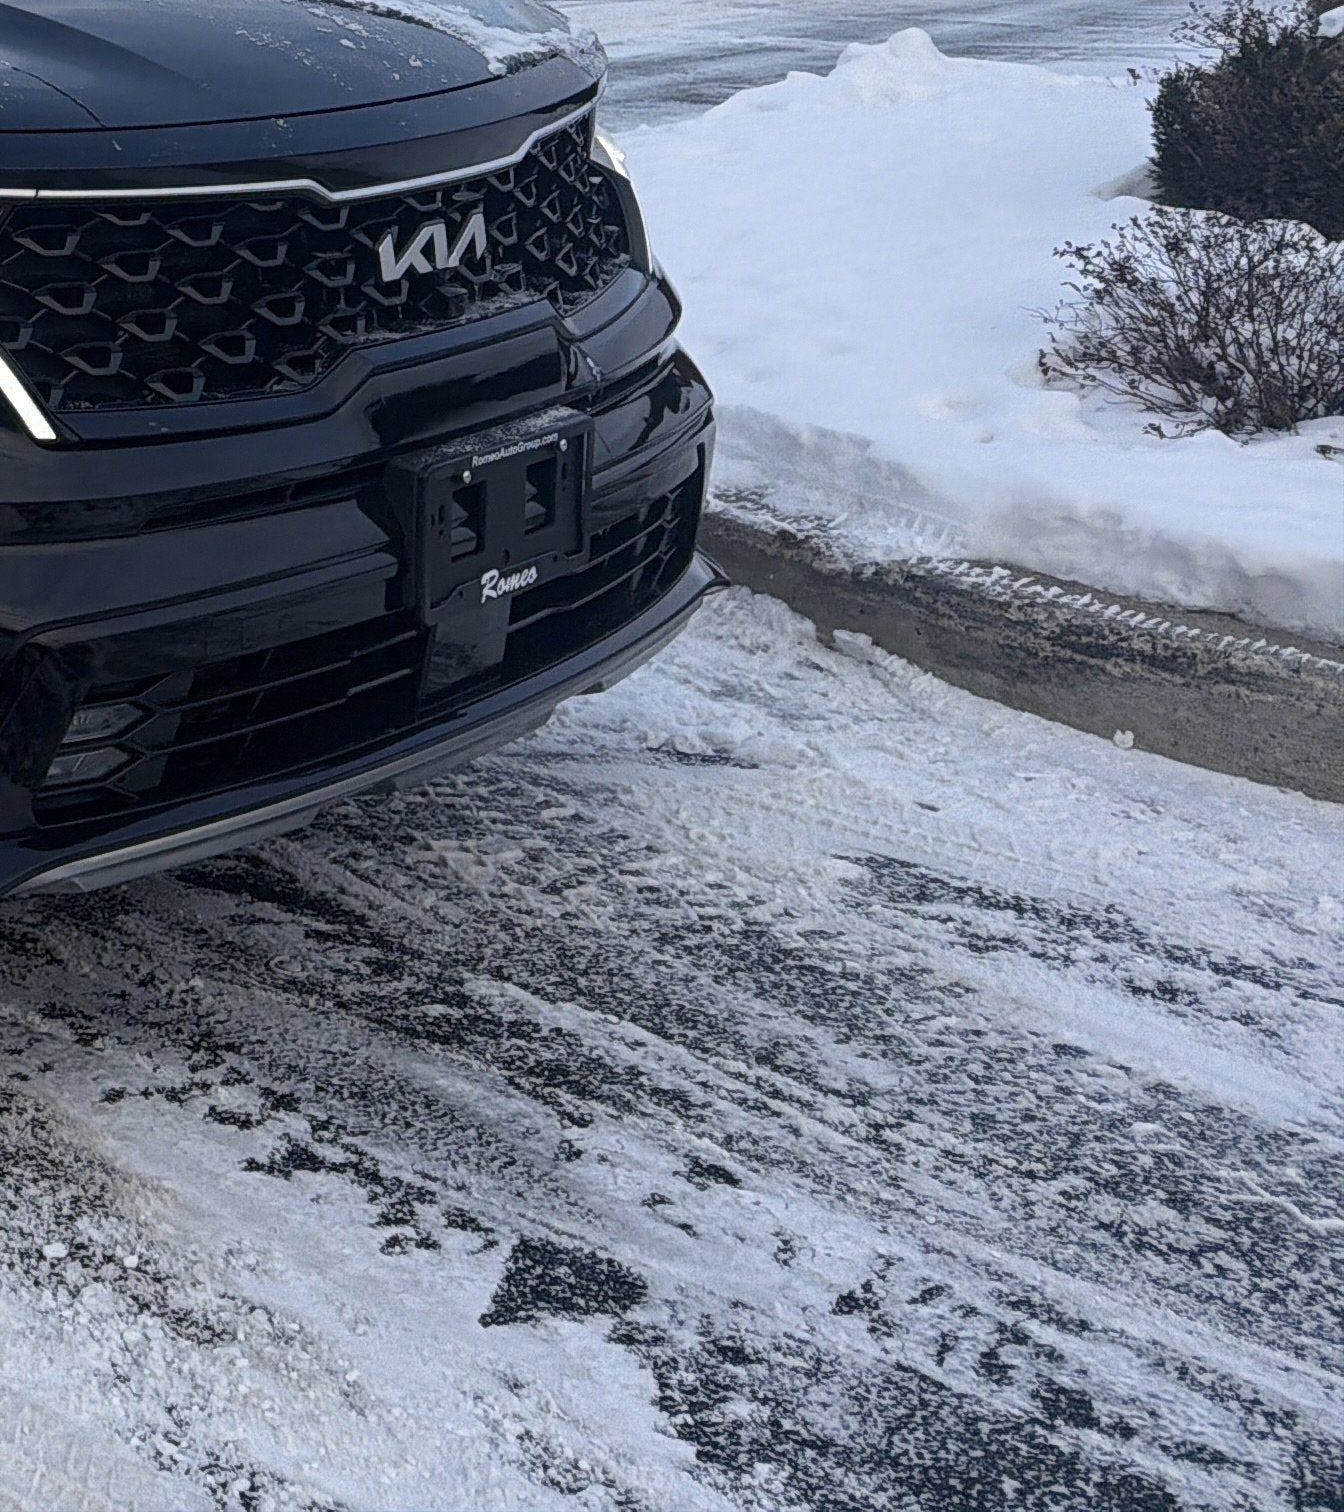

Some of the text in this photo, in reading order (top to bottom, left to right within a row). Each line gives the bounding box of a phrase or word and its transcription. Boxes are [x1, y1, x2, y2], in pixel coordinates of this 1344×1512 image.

[378, 213, 487, 282] KIA
[472, 433, 559, 468] RomeoAutoGroup.com
[481, 566, 538, 604] Romeo
